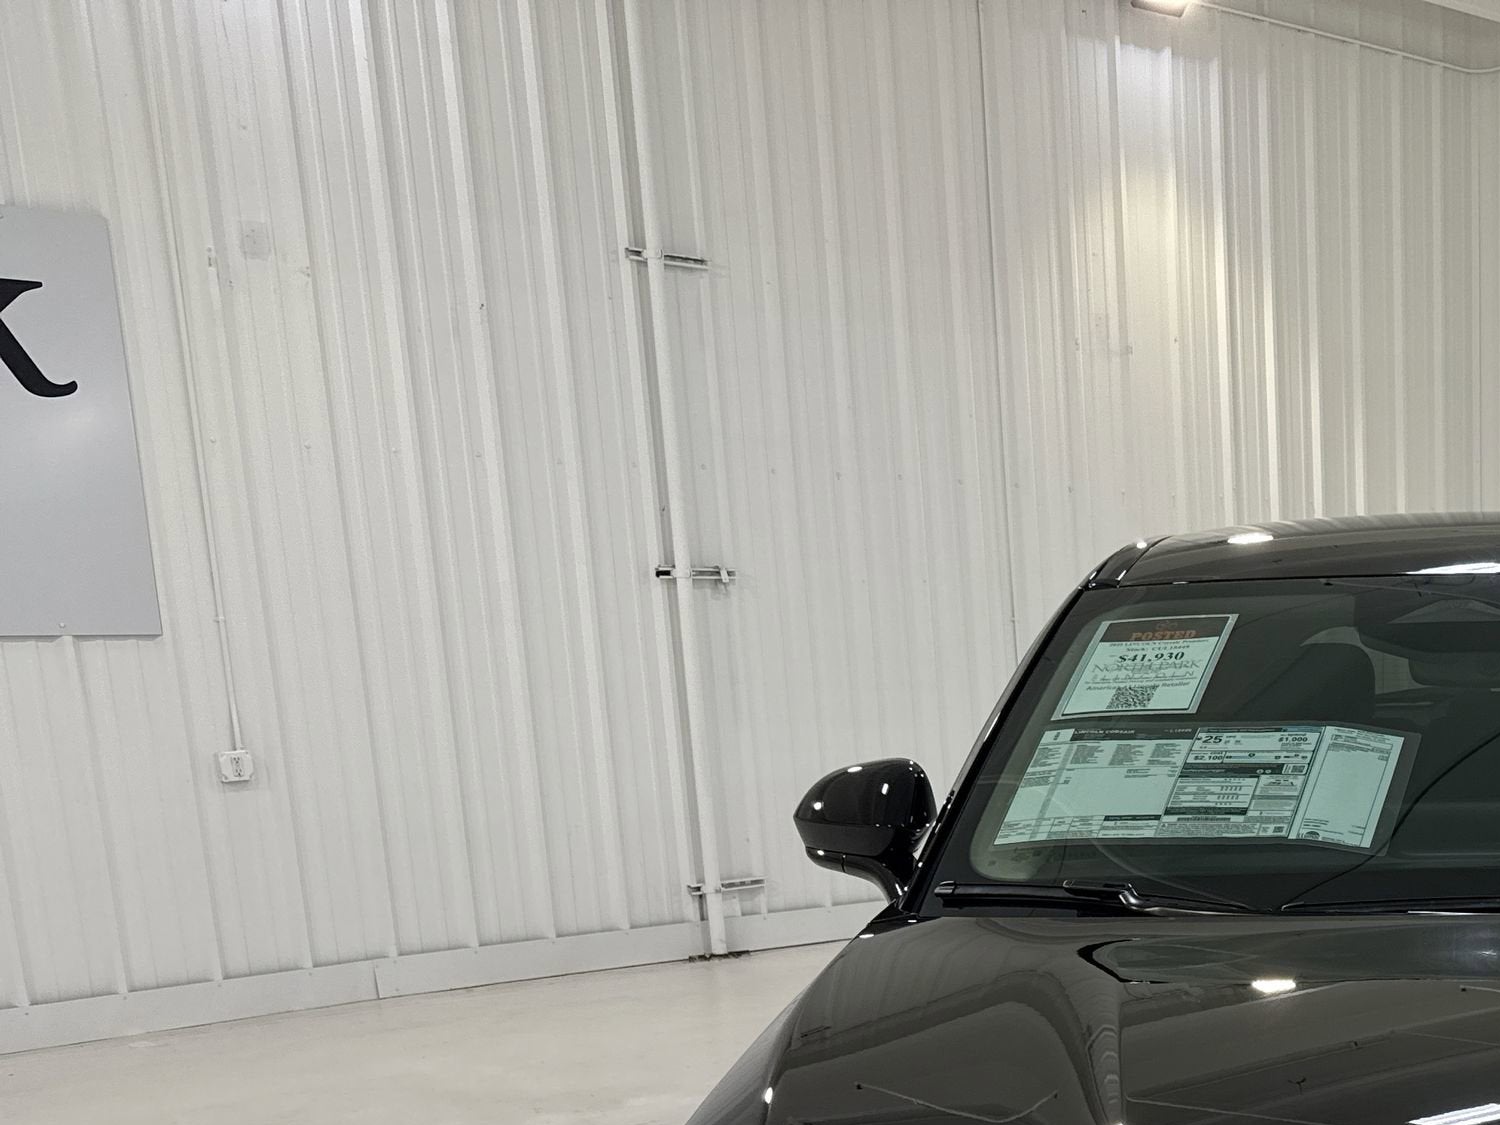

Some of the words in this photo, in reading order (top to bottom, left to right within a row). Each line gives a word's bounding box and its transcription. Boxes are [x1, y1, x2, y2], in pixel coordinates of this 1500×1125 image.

[1130, 631, 1197, 641] POSTED
[1118, 651, 1185, 663] $41,930
[1202, 735, 1223, 744] 25
